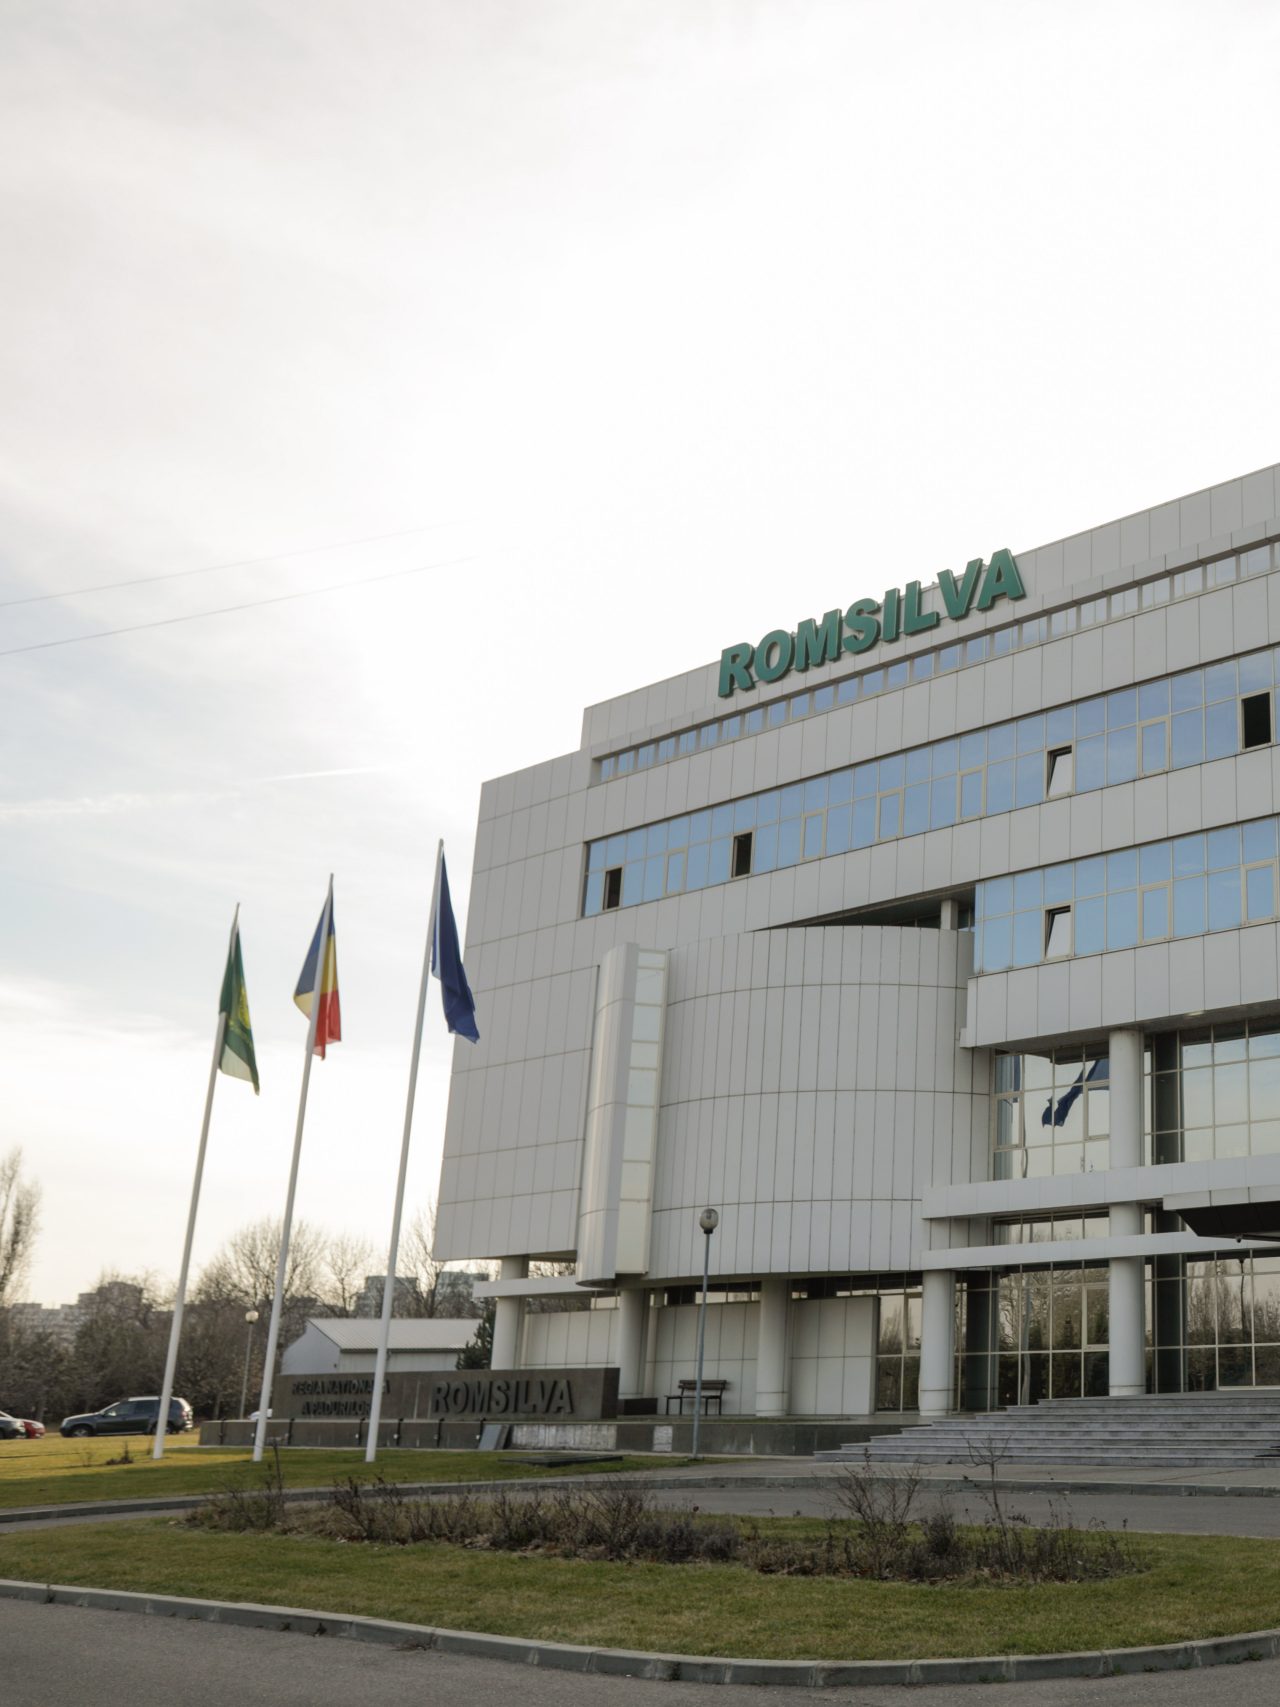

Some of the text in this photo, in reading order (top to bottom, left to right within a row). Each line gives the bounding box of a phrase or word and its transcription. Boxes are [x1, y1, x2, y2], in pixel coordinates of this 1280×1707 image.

[718, 548, 1026, 697] ROMSILVA
[325, 1379, 391, 1394] NATIONAA
[431, 1379, 575, 1414] ROMSILVA
